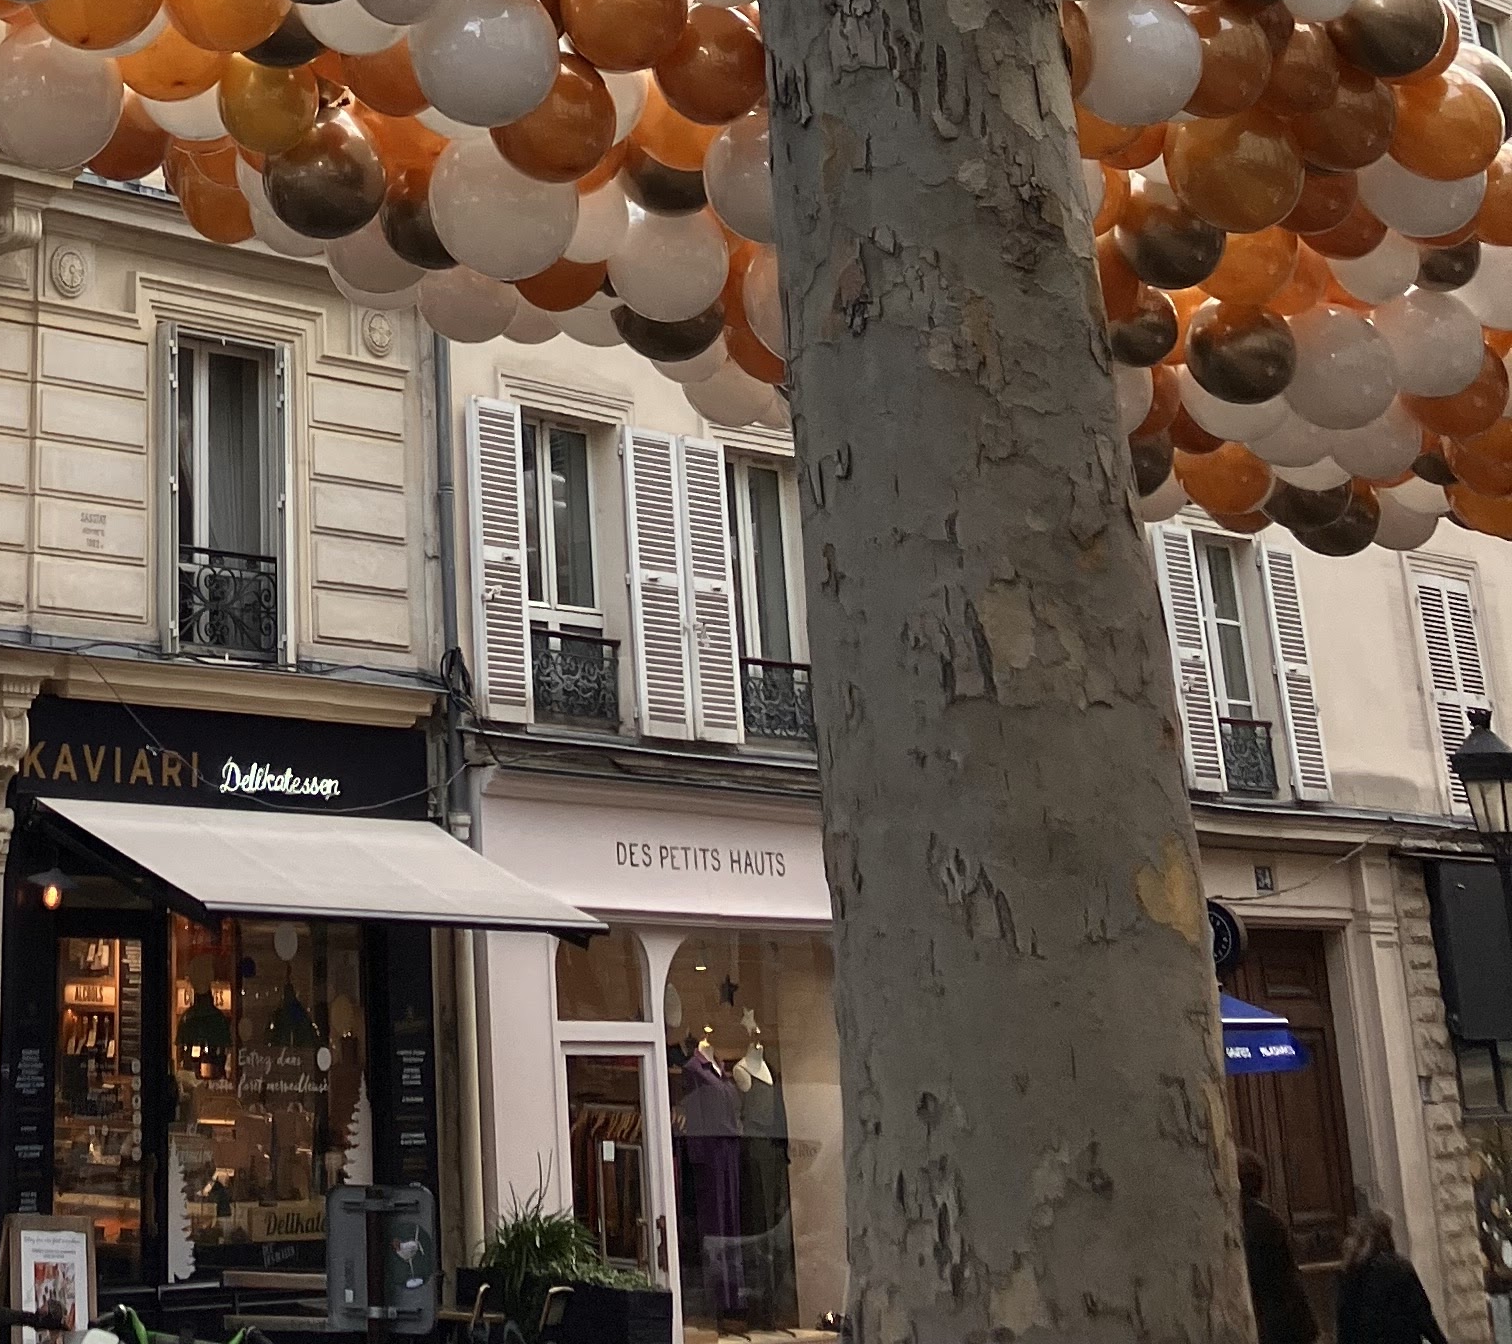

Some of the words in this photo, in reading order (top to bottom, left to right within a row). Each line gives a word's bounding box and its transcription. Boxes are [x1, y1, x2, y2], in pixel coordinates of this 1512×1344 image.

[23, 741, 199, 788] KAVIARI
[220, 757, 341, 800] Delikatessen
[616, 841, 652, 868] DES
[659, 844, 721, 873] PETITS
[729, 849, 786, 878] HAUTS
